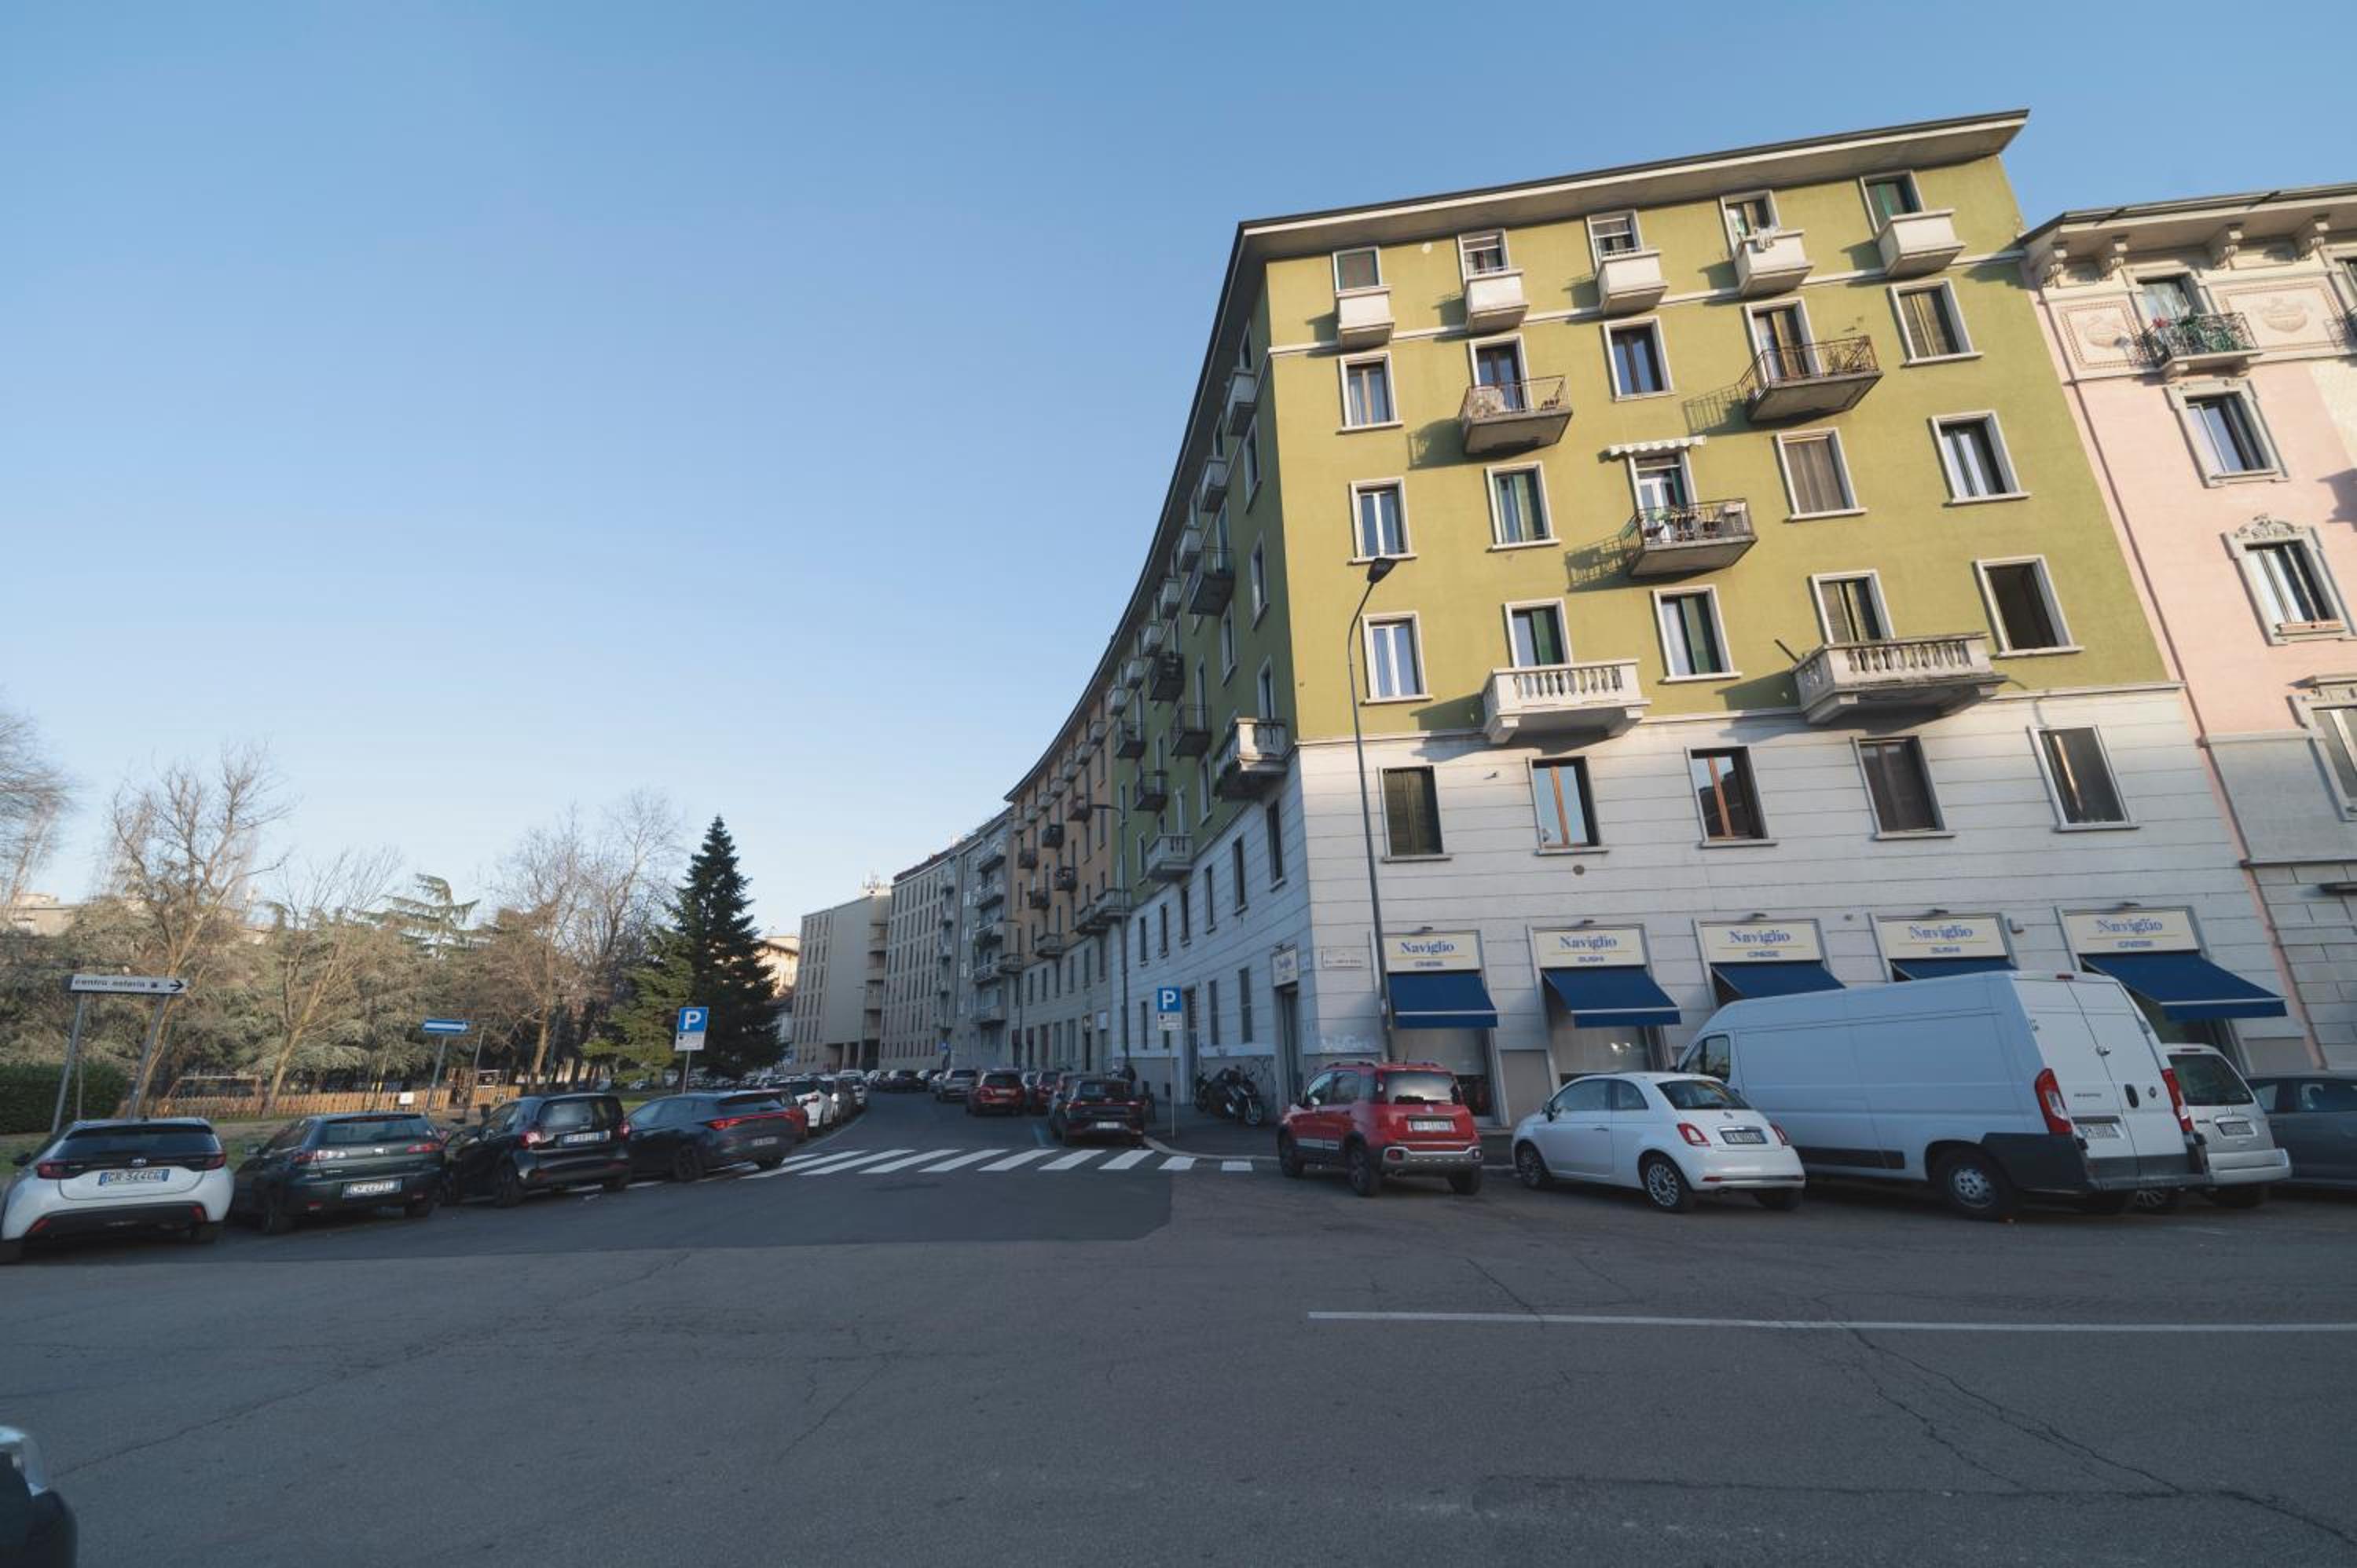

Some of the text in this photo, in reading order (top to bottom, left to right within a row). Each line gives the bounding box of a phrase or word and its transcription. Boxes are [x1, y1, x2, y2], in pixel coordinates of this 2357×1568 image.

[1909, 925, 1974, 940] Naviglio
[2096, 918, 2163, 934] Naviglio
[1560, 936, 1617, 951] Naviglio
[1729, 930, 1791, 945] Naviglio
[1401, 940, 1454, 955] Naviglio
[1162, 990, 1176, 1009] P
[683, 1011, 702, 1030] P
